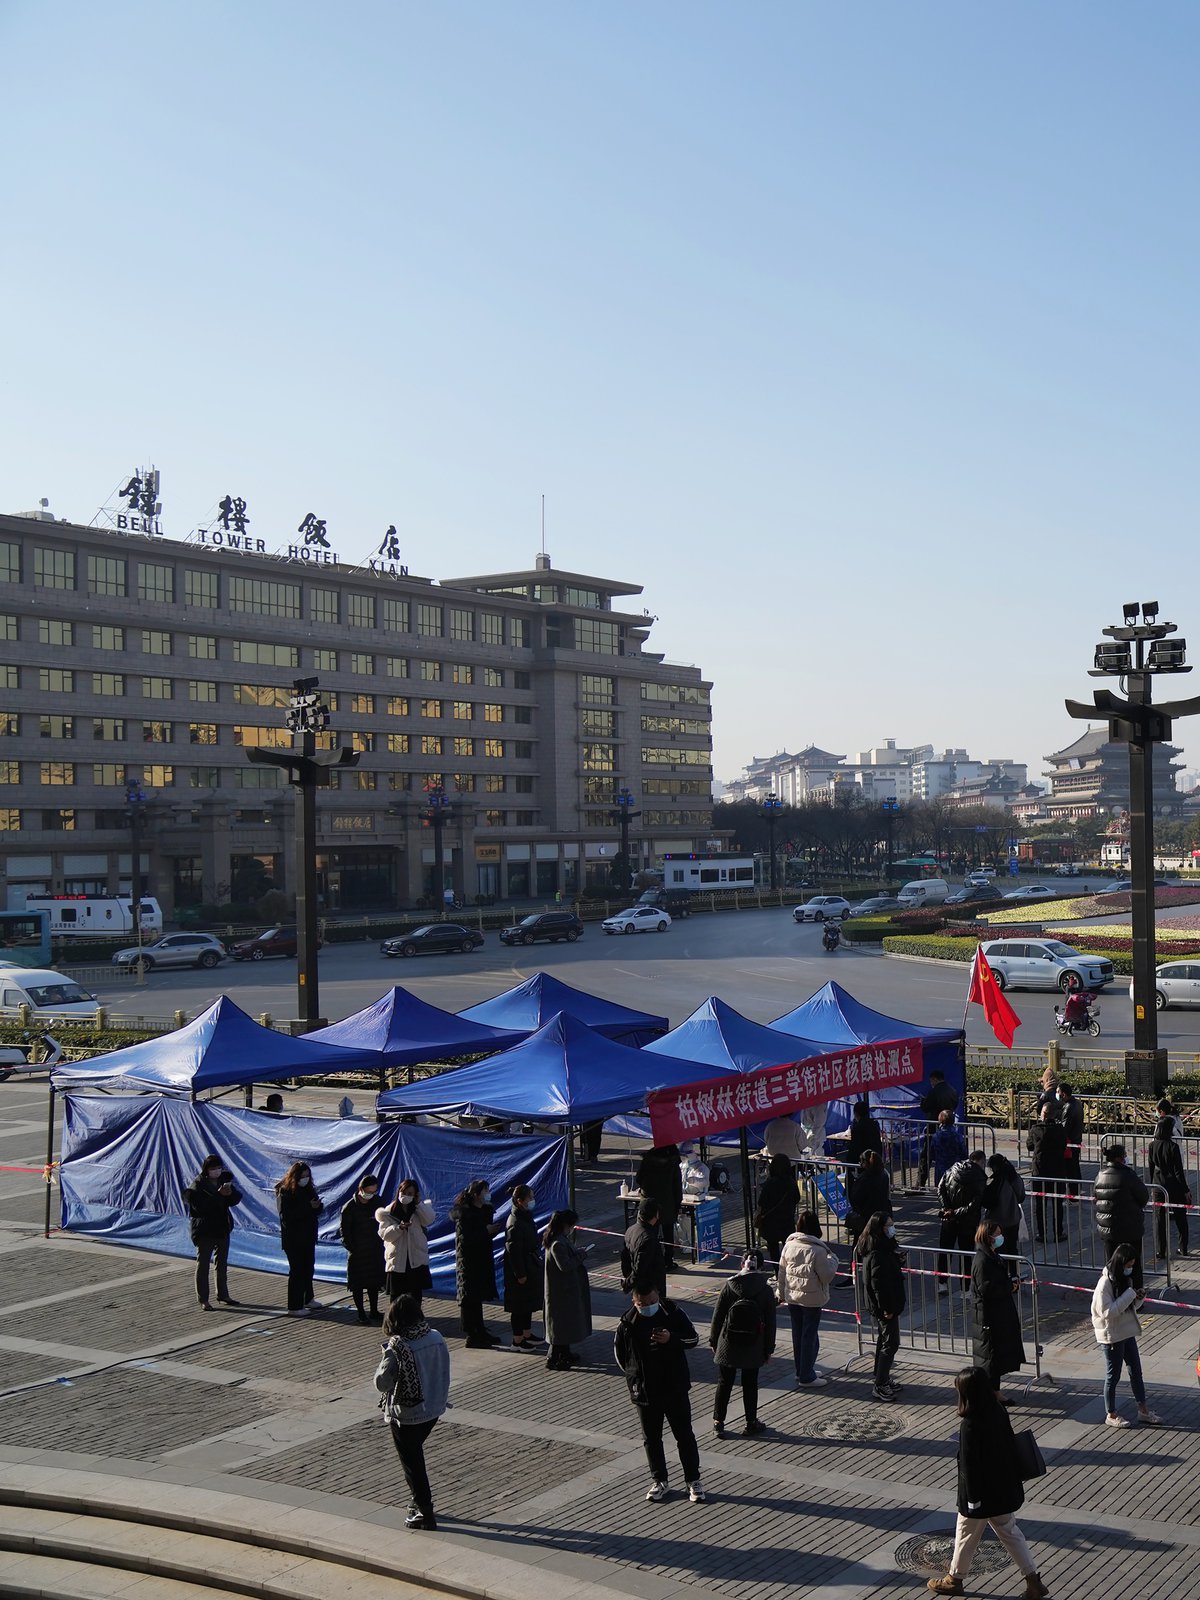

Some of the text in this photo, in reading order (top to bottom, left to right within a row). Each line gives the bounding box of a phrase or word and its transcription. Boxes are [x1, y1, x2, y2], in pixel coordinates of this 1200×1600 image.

[116, 514, 163, 536] BELL
[197, 528, 265, 553] TOWER
[674, 1046, 914, 1129] 柏树林街道三学街社区核酸检测点
